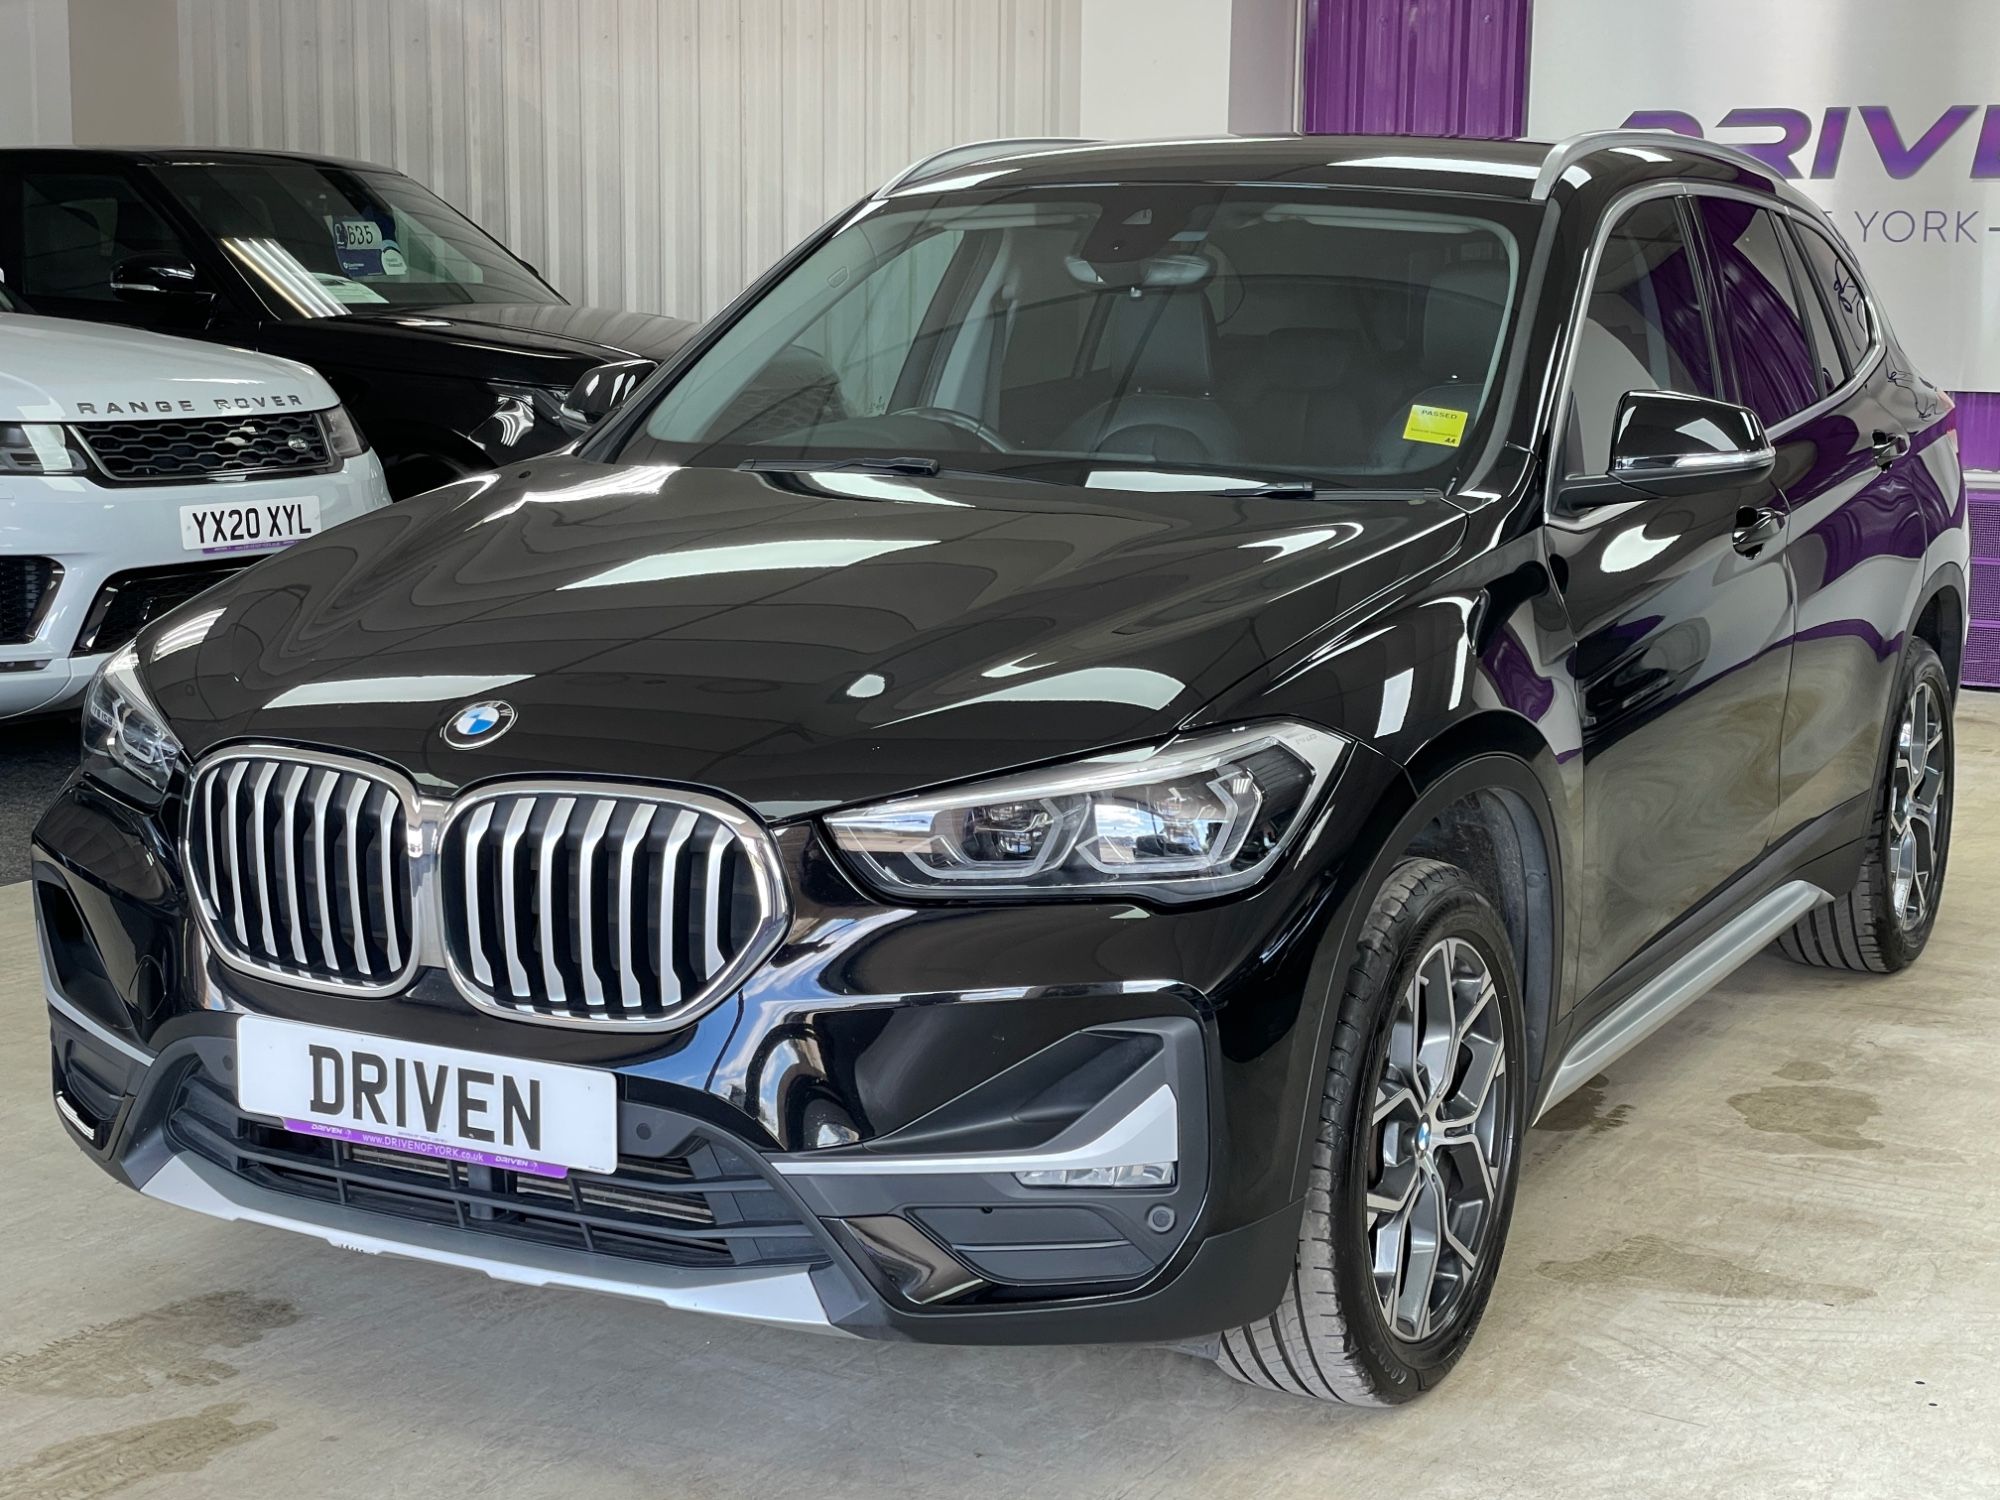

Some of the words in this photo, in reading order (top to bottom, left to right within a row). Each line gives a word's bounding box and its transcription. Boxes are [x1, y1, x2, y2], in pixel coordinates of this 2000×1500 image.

[1854, 210, 1979, 243] YORK
[77, 400, 195, 415] RANGE
[213, 394, 303, 409] ROVER
[1422, 409, 1458, 420] PASSED
[192, 507, 261, 544] YX20
[267, 503, 312, 538] XYL
[309, 1043, 541, 1152] DRIVEN
[311, 1123, 343, 1136] DRIVEN
[362, 1133, 484, 1163] www.DRIVENOFYORK.co.uk
[495, 1154, 529, 1168] DRIVEN
